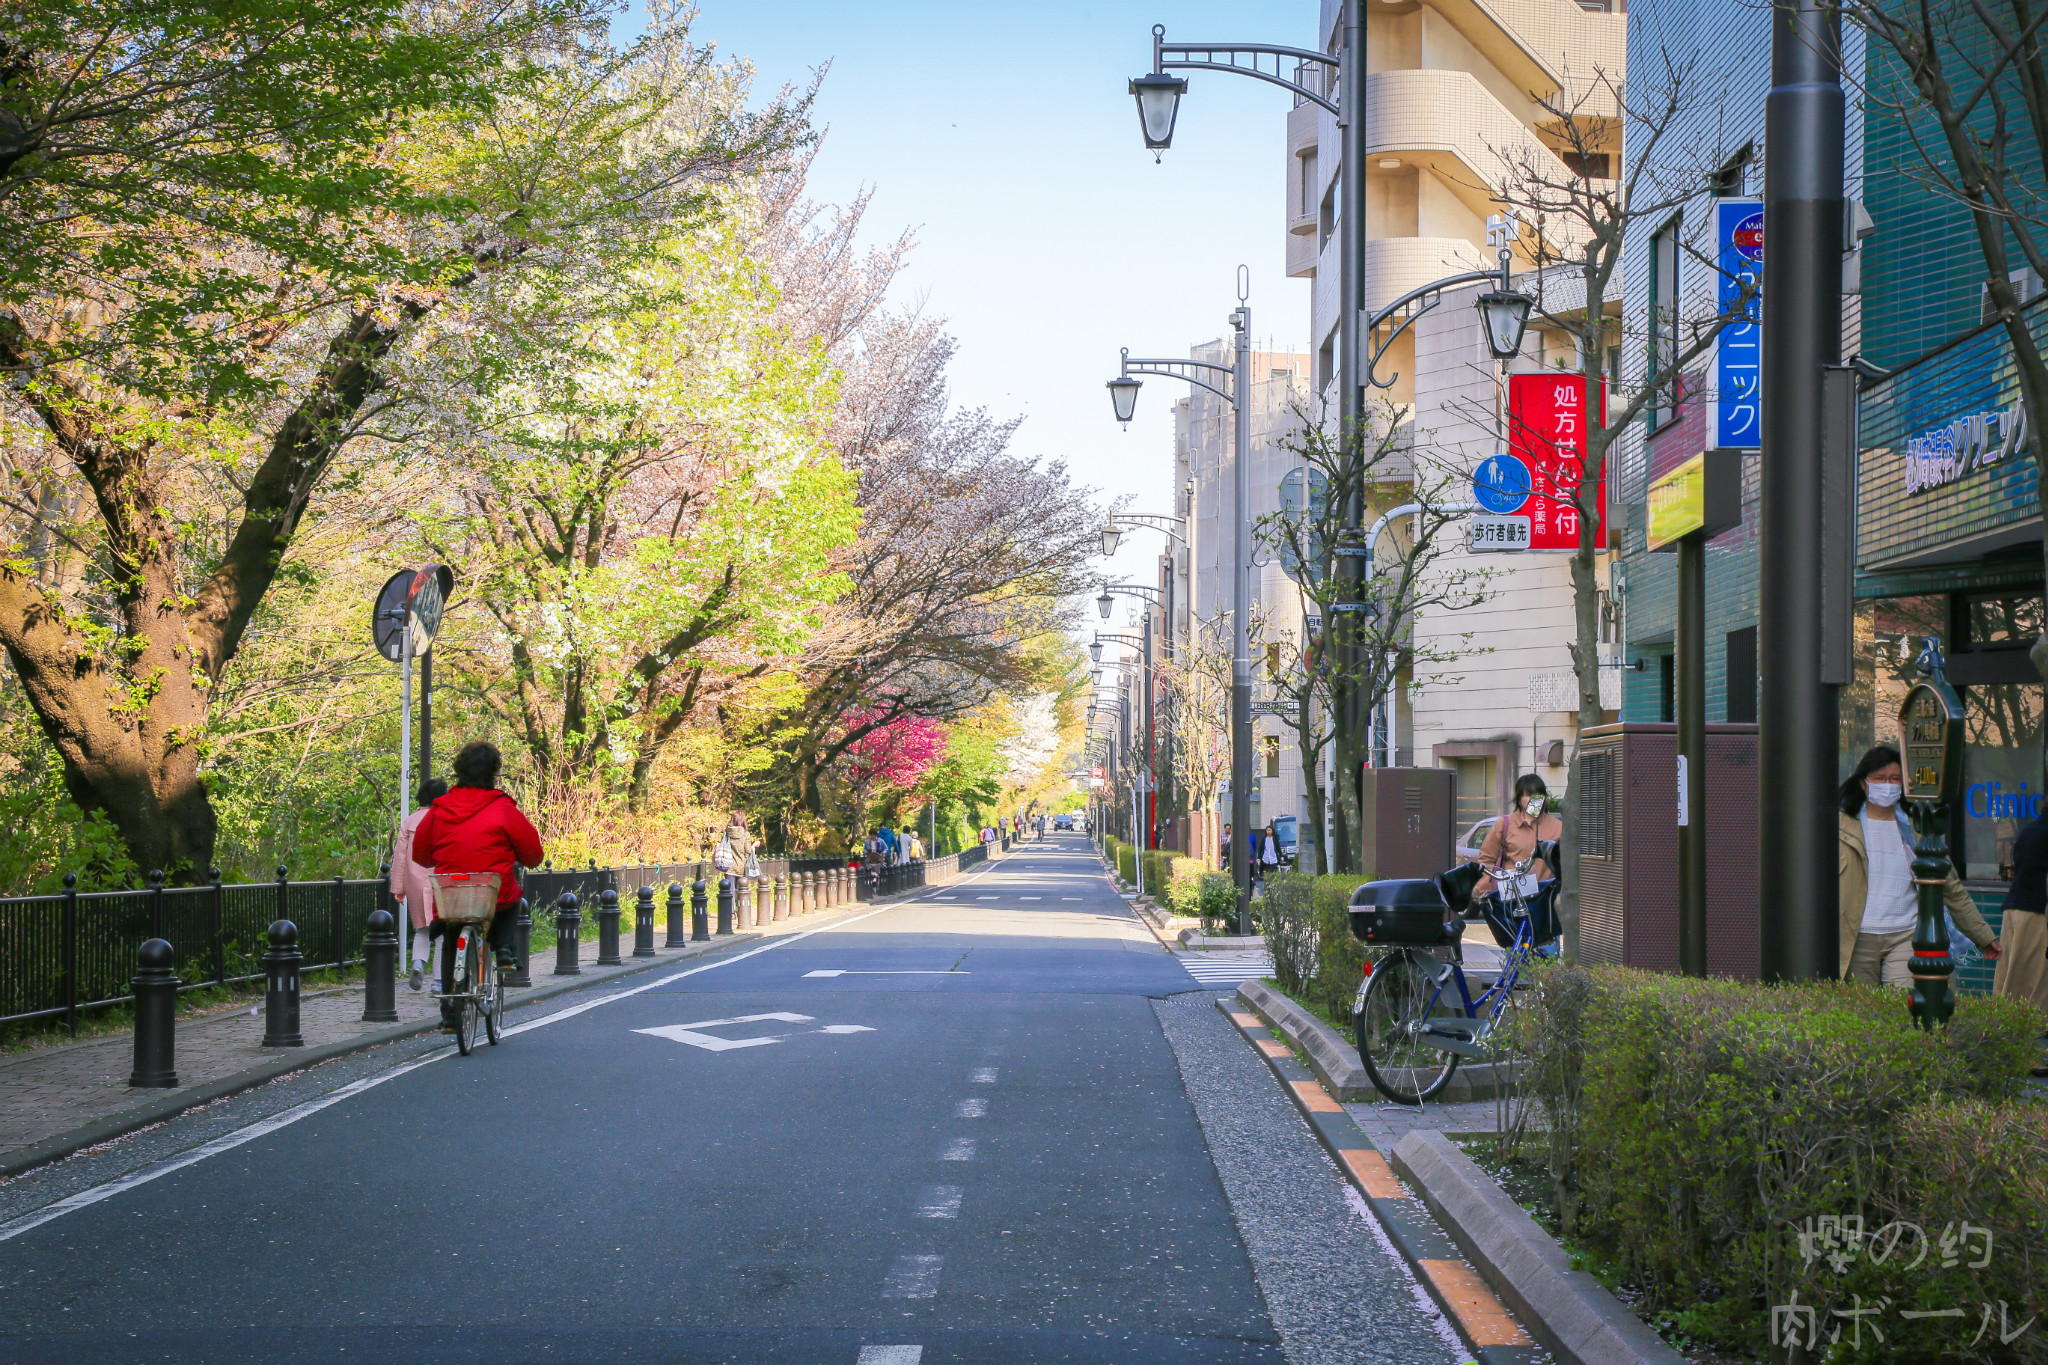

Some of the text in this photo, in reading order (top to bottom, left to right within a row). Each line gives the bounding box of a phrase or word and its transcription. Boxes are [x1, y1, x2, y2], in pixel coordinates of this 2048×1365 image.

[1553, 384, 1578, 535] 処方せん受付
[1474, 523, 1528, 542] 歩行者優先
[1966, 781, 2044, 819] Clinic
